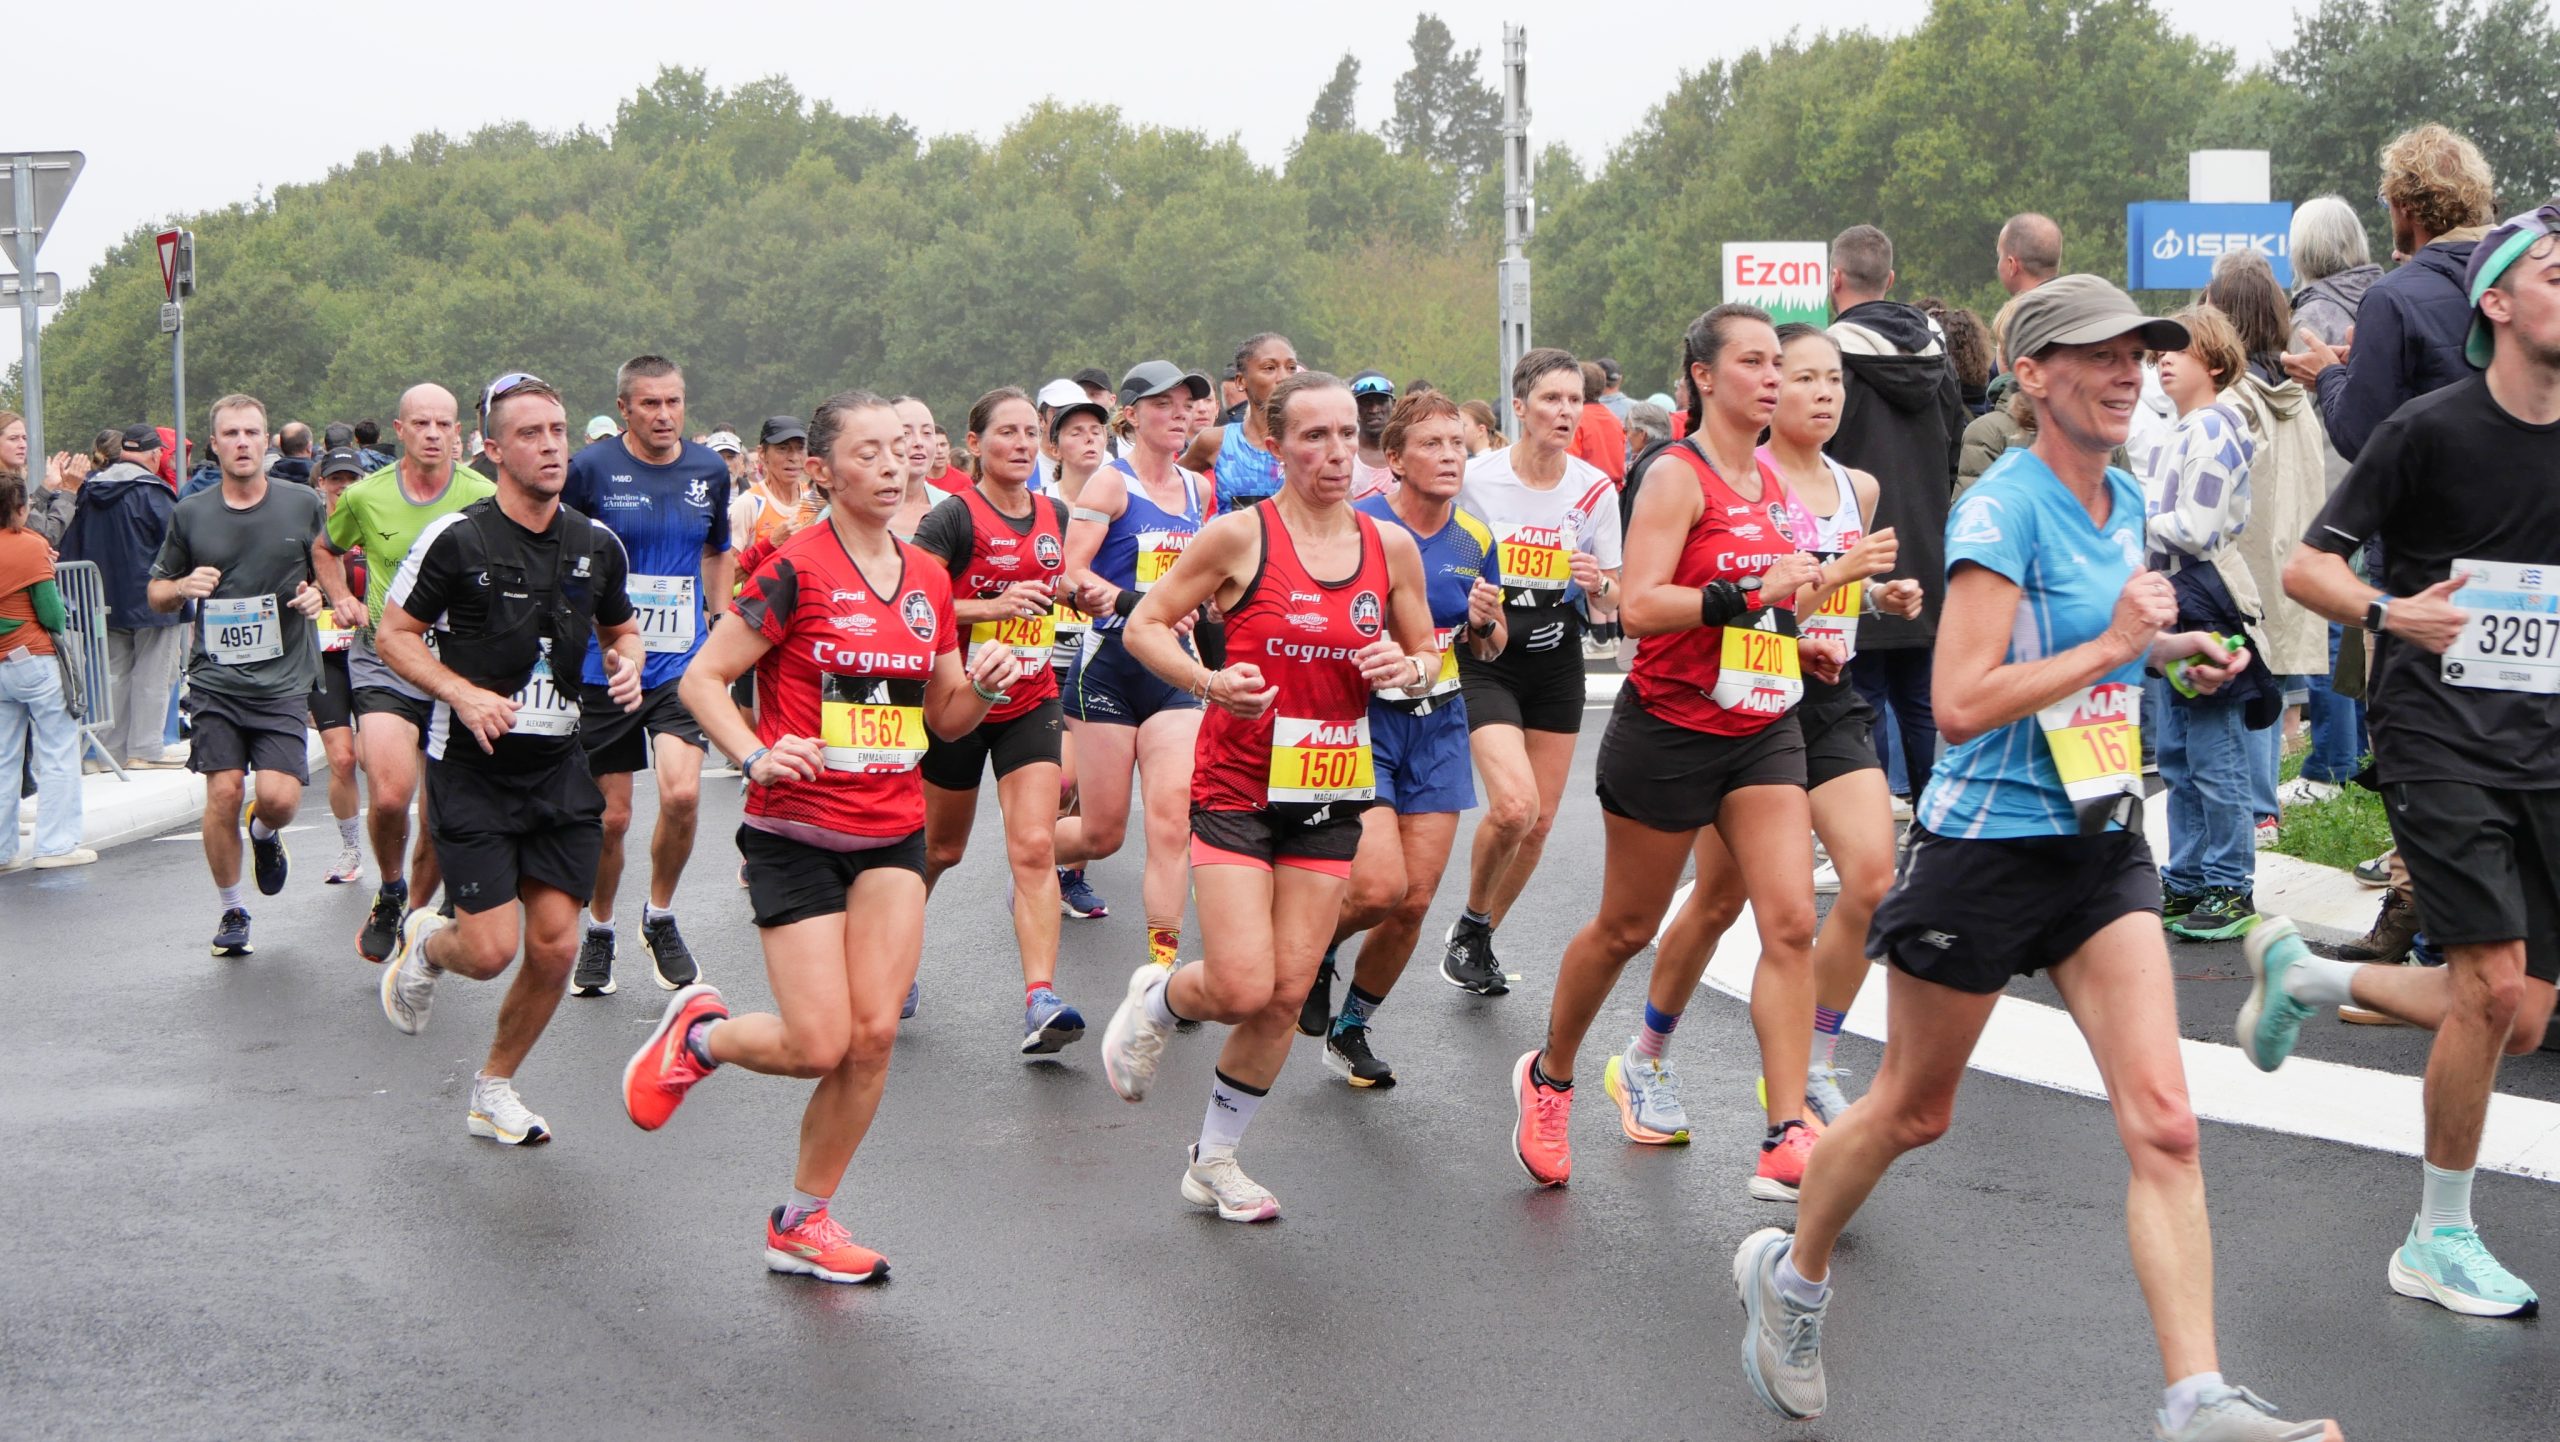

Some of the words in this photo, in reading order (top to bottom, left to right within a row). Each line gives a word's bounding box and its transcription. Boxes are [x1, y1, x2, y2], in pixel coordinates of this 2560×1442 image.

[2187, 233, 2286, 257] ISEKI
[1736, 255, 1822, 286] Ezan
[1514, 528, 1561, 547] MAIF
[1507, 547, 1553, 578] 1931
[220, 624, 263, 648] 4957
[995, 617, 1043, 646] 1248
[2479, 615, 2560, 659] 3297
[813, 641, 924, 674] Cognac
[1743, 633, 1783, 674] 1210
[1742, 691, 1786, 715] MAIF
[847, 707, 907, 747] 1562
[1300, 751, 1357, 788] 1507
[1361, 788, 1372, 799] M2
